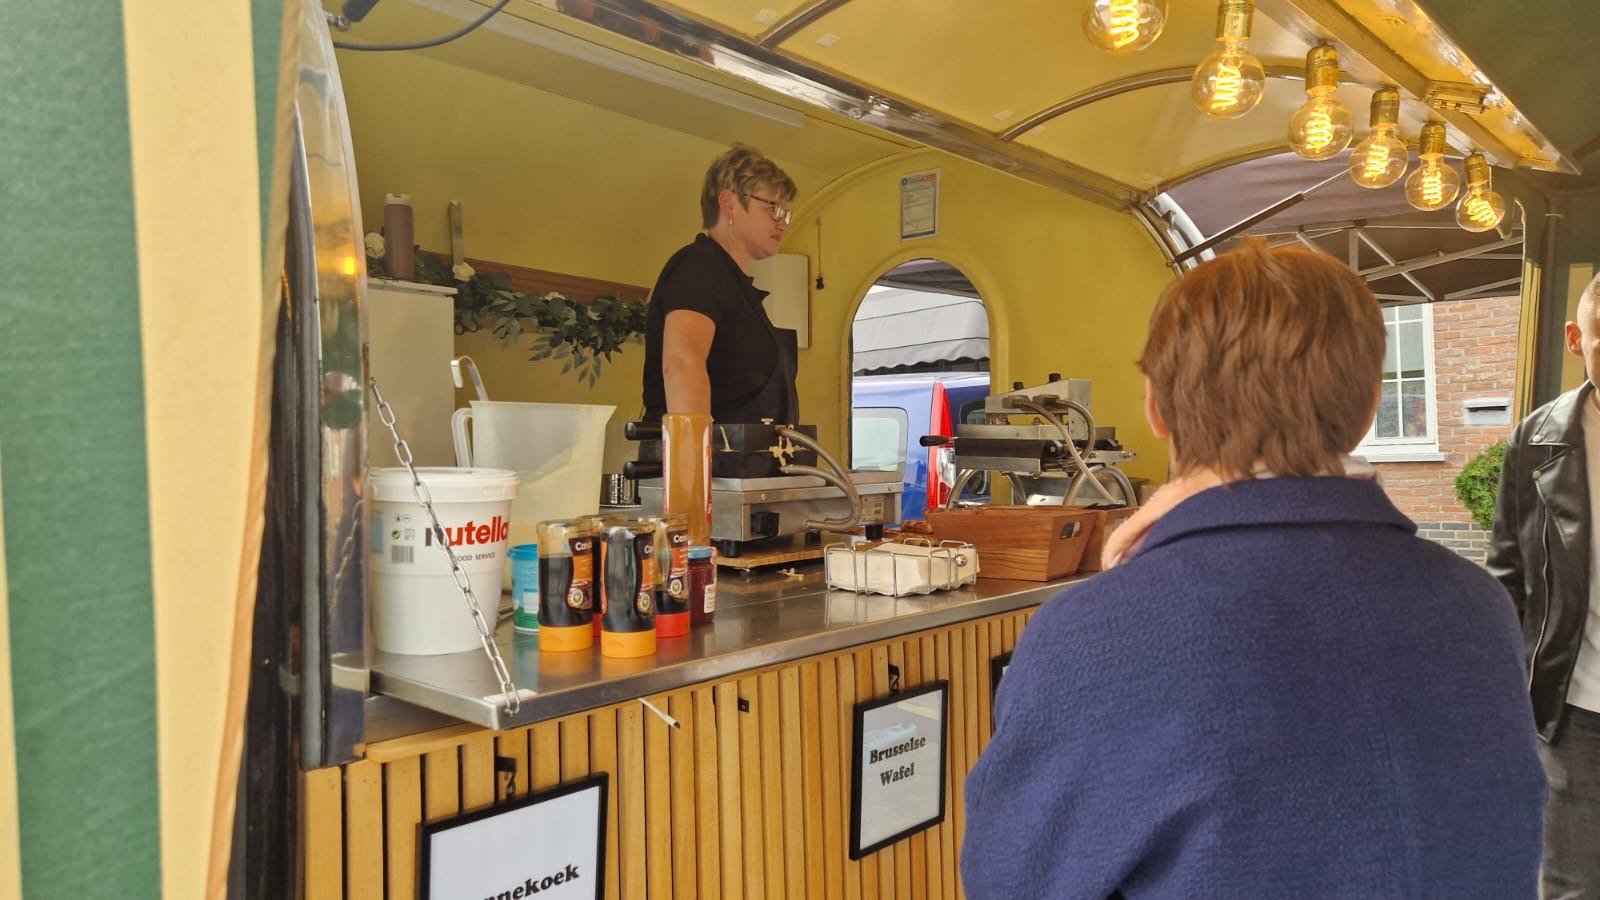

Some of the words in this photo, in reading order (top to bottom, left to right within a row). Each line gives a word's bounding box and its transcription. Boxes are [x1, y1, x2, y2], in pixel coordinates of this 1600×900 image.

[425, 516, 509, 547] nutella
[870, 737, 926, 764] Brusselse
[880, 762, 914, 786] Wafel
[484, 864, 580, 900] nekoek
